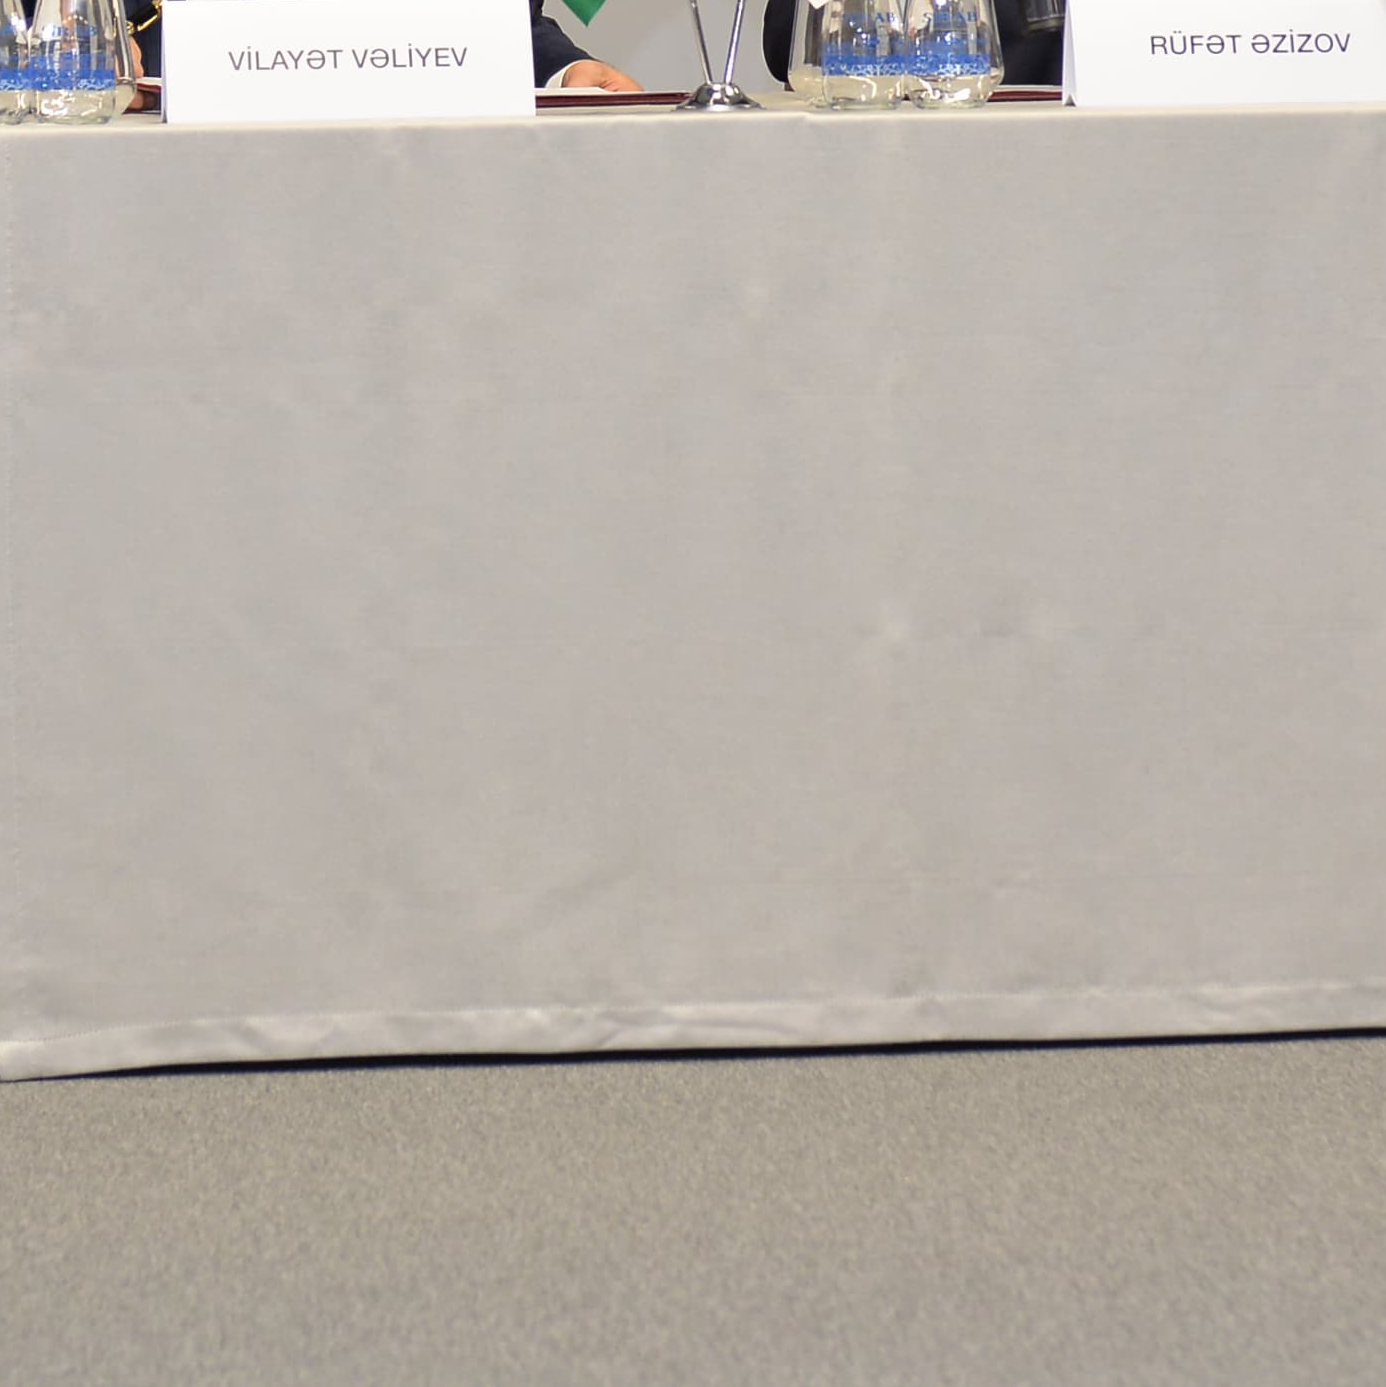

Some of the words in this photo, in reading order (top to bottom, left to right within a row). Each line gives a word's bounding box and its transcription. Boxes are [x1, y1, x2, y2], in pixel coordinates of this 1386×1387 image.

[1150, 30, 1243, 56] RÜFƏT
[1251, 29, 1351, 54] ƏZİZOV
[228, 45, 344, 71] VİLAYƏT
[351, 43, 468, 69] VƏLİYEV
